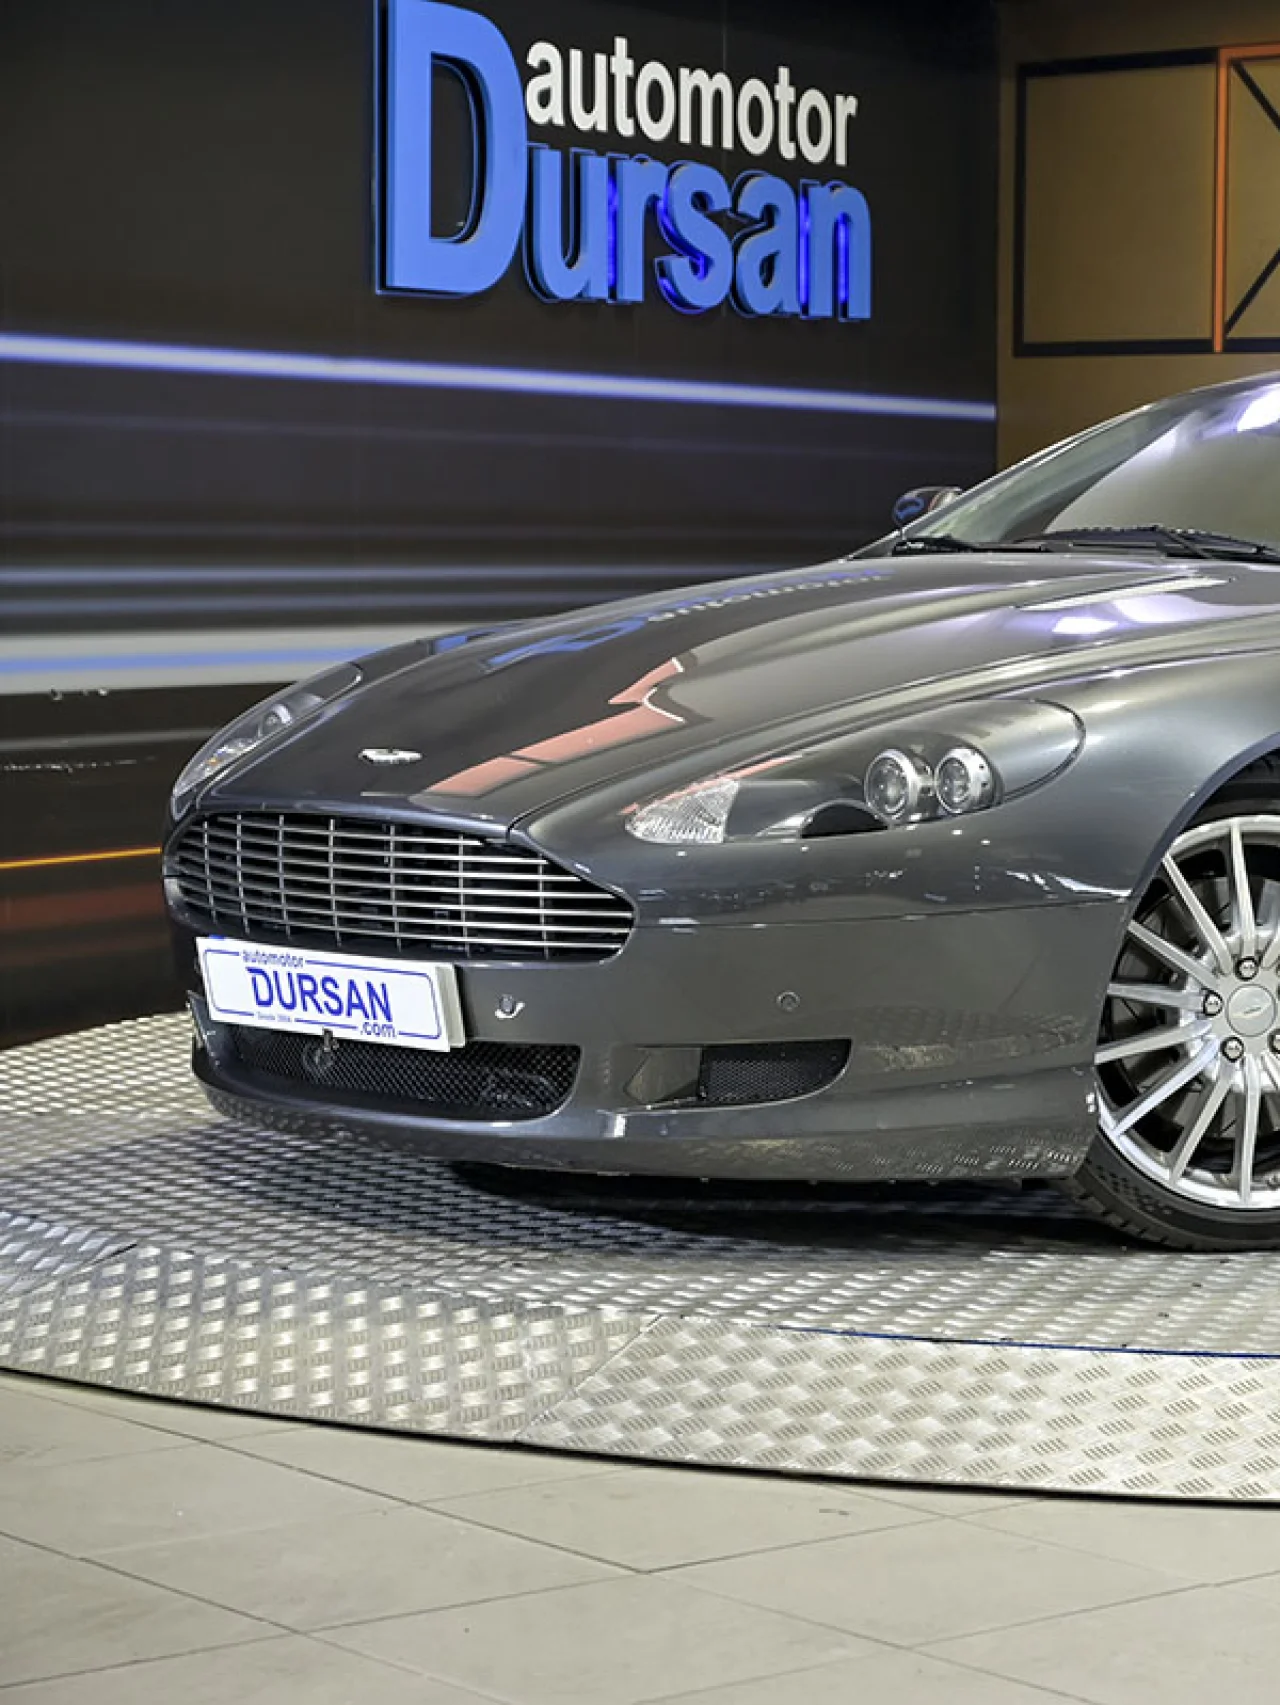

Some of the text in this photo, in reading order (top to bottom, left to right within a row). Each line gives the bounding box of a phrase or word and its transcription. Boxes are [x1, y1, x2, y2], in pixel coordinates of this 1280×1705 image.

[526, 36, 857, 166] automotor
[376, 0, 872, 321] Dursan
[243, 950, 304, 967] automotor
[247, 966, 393, 1022] DURSAN
[360, 1021, 397, 1038] .com
